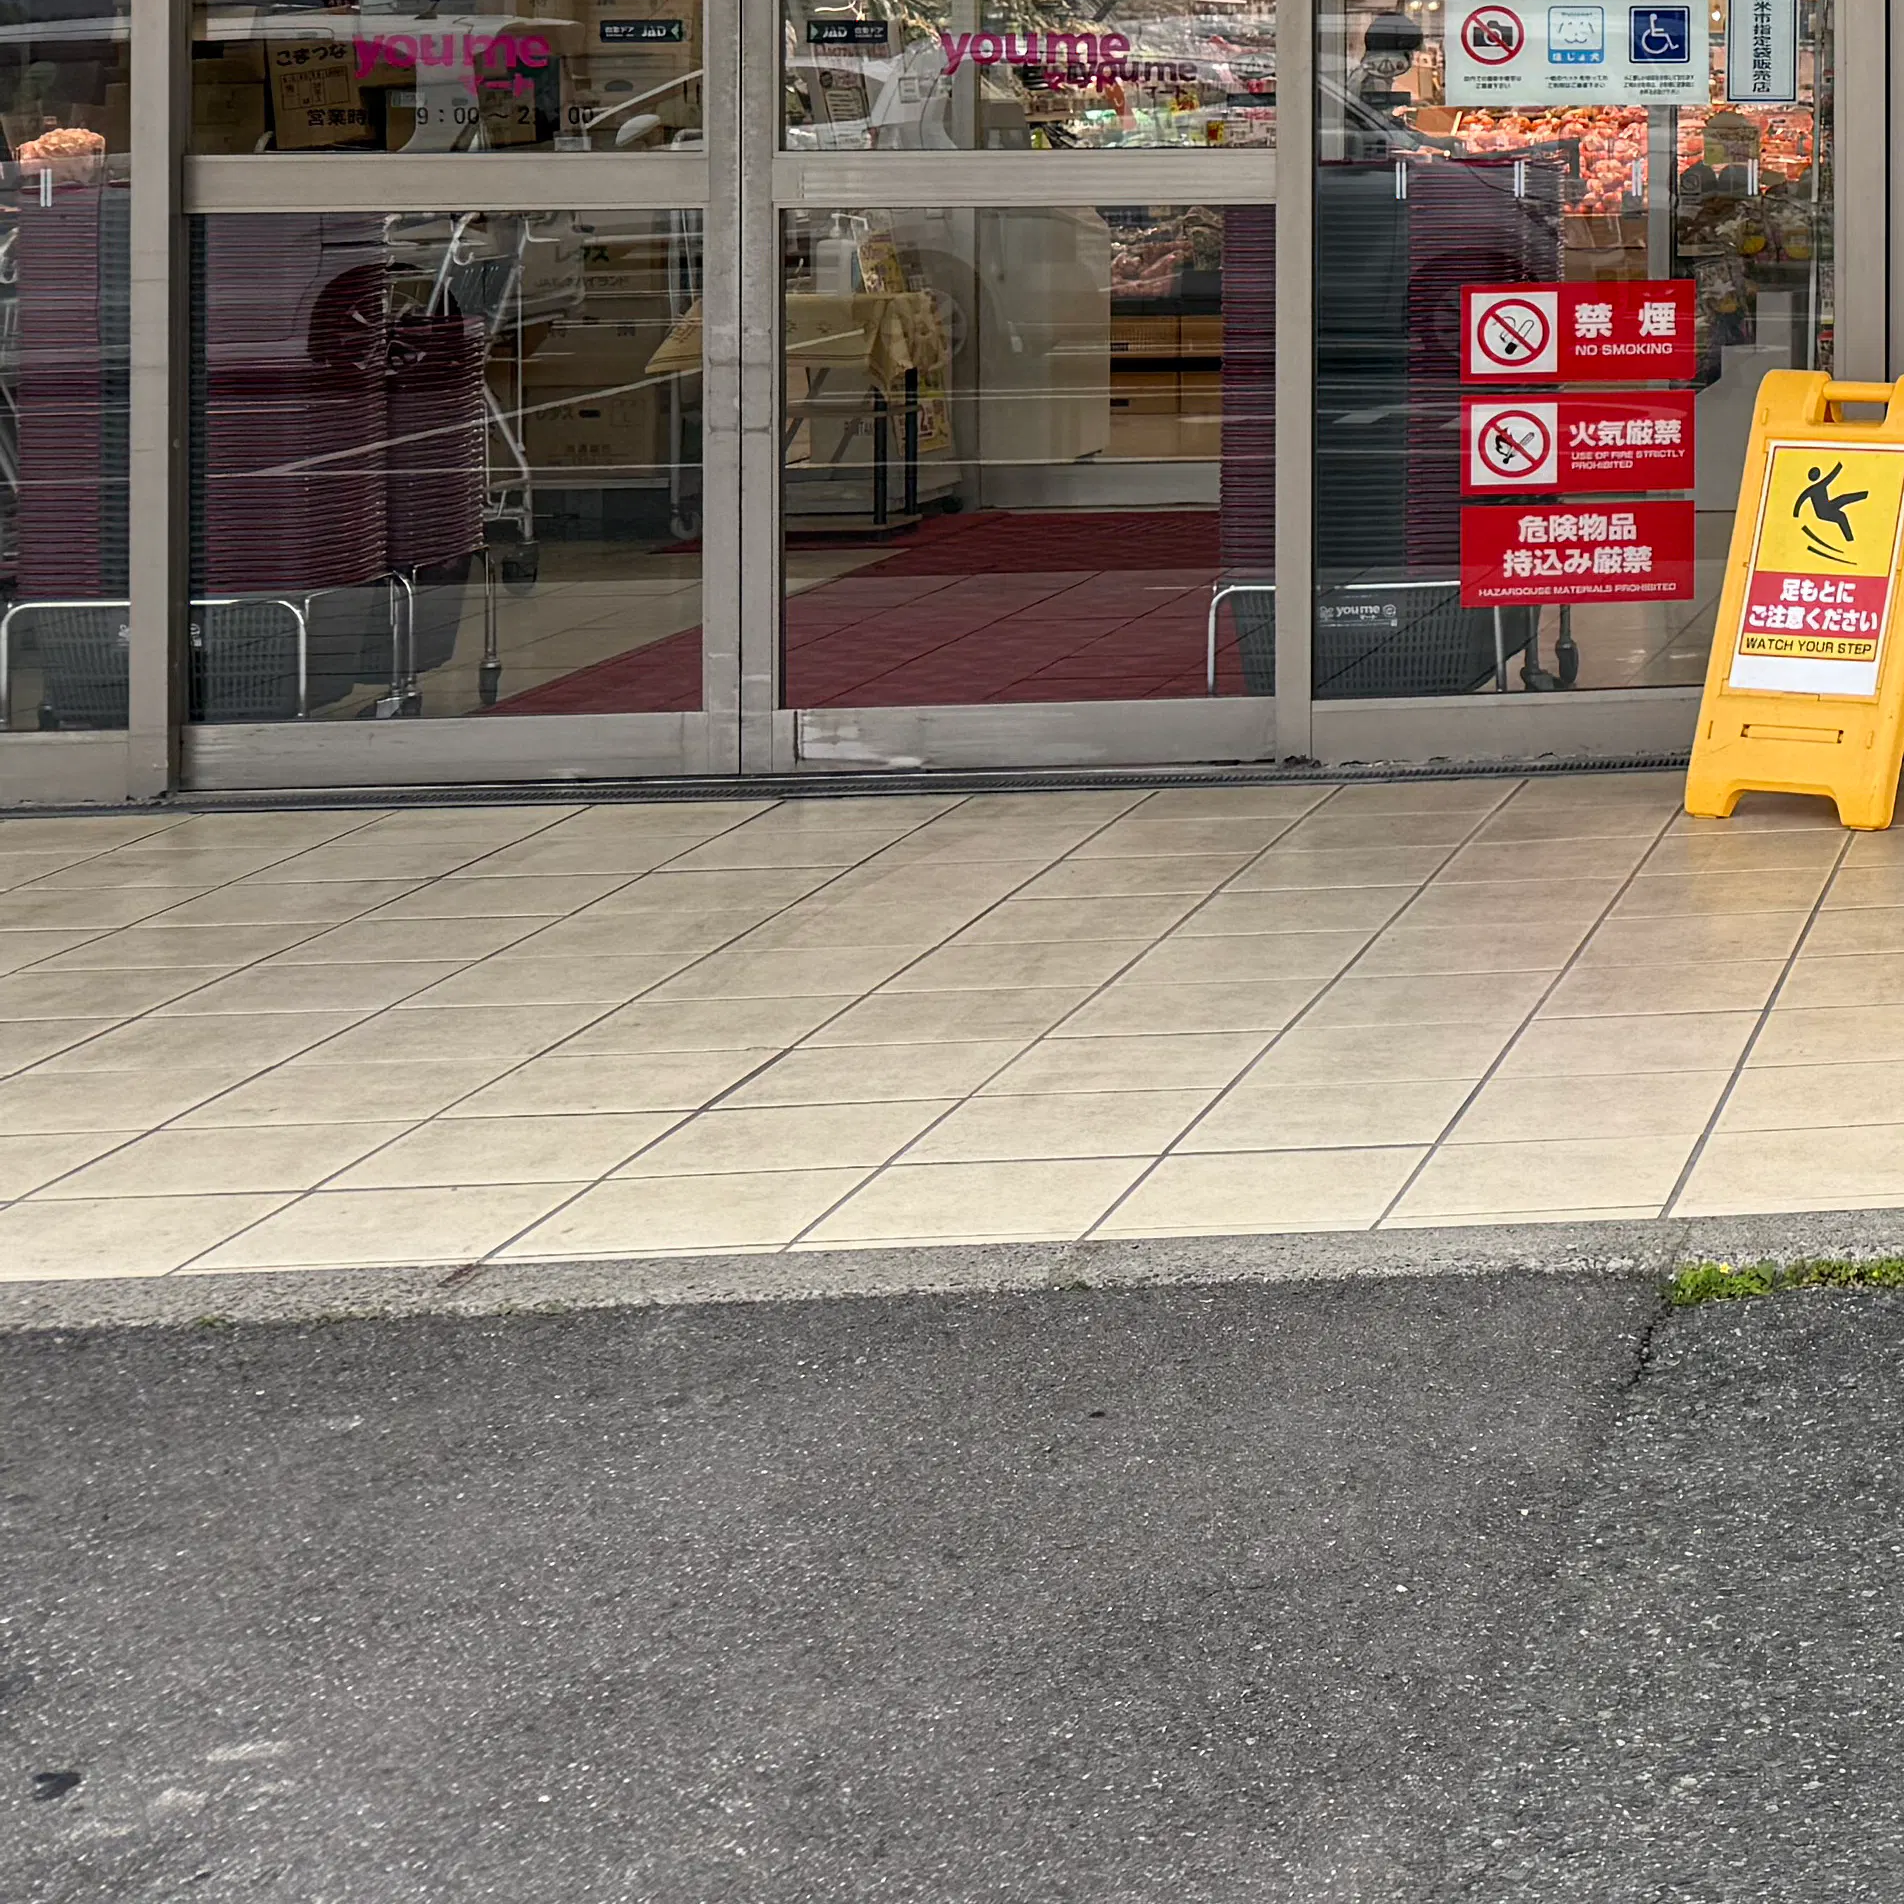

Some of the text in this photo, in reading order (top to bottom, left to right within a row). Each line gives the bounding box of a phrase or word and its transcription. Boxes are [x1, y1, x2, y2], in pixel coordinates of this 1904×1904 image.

[1574, 301, 1677, 339] 禁煙
[1575, 342, 1673, 356] NO SMOKING
[1568, 419, 1682, 447] 火気厳禁
[1571, 448, 1685, 461] USE OF FIRE STRICTLY
[1571, 459, 1634, 470] PROHIBITED
[1517, 512, 1637, 543] 危険物品
[1502, 546, 1653, 578] 持込み厳禁
[1553, 584, 1613, 595] MATERIALS
[1614, 582, 1677, 593] PROHIBITED
[1779, 578, 1857, 604] 足もとに
[1748, 604, 1878, 632] ご注意ください
[1745, 637, 1873, 656] WATCH YOUR STEP
